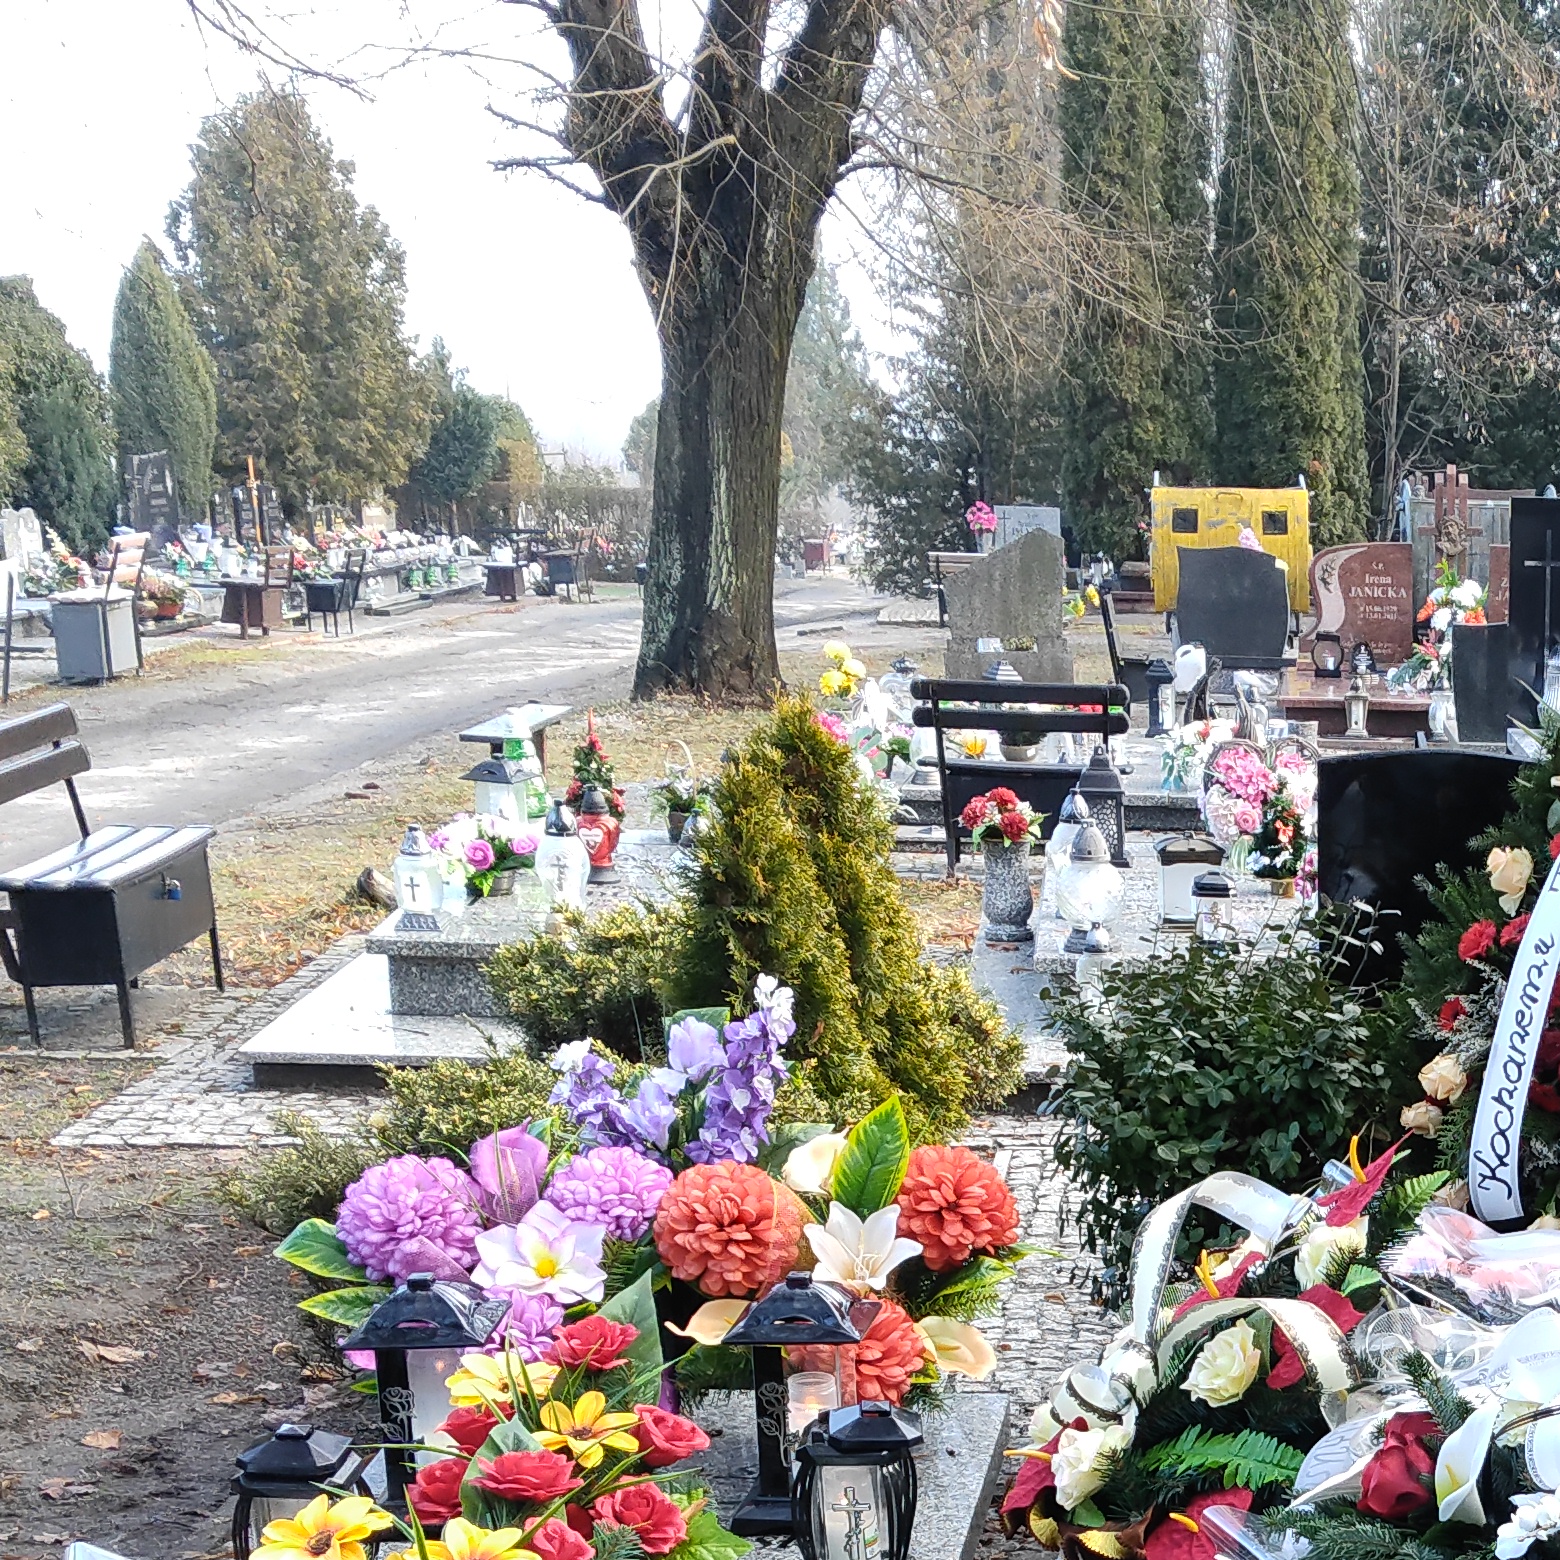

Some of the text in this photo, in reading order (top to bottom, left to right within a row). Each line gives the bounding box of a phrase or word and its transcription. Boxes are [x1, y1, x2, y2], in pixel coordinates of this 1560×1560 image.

[1365, 573, 1392, 584] Irena
[1349, 586, 1407, 598] JANICKA
[1474, 930, 1556, 1201] Kochanemu
